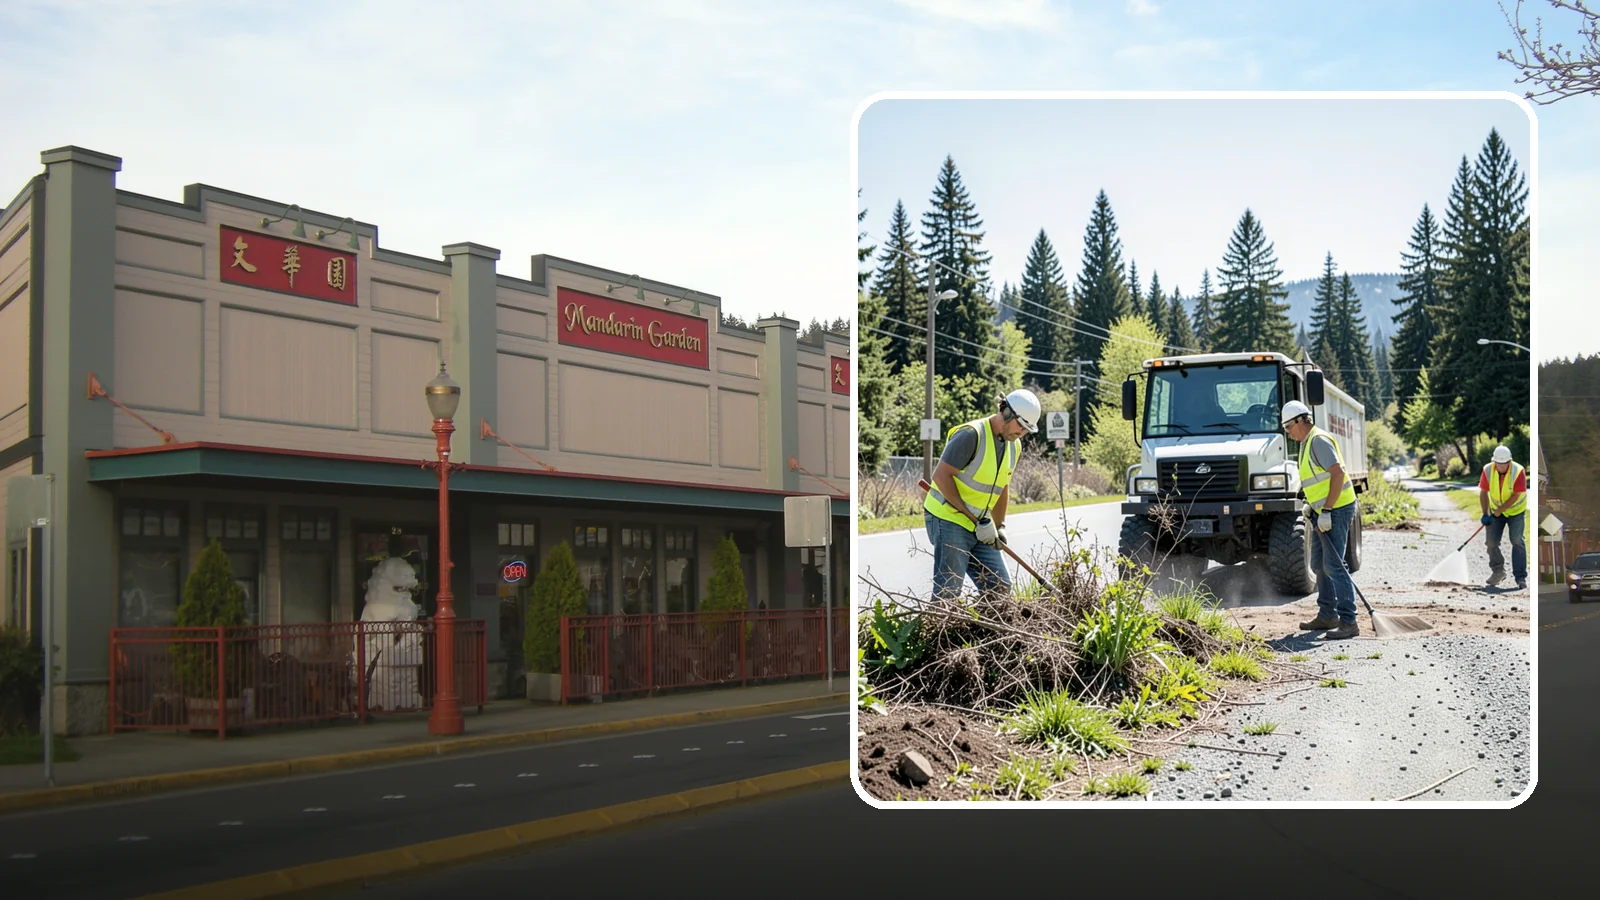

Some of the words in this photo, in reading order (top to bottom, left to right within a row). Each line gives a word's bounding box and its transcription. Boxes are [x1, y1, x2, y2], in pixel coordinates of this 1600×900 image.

[230, 235, 347, 291] 文華園
[564, 302, 644, 341] Mandarin
[647, 320, 702, 352] Garden
[834, 363, 846, 386] 文
[503, 565, 527, 578] OPEN
